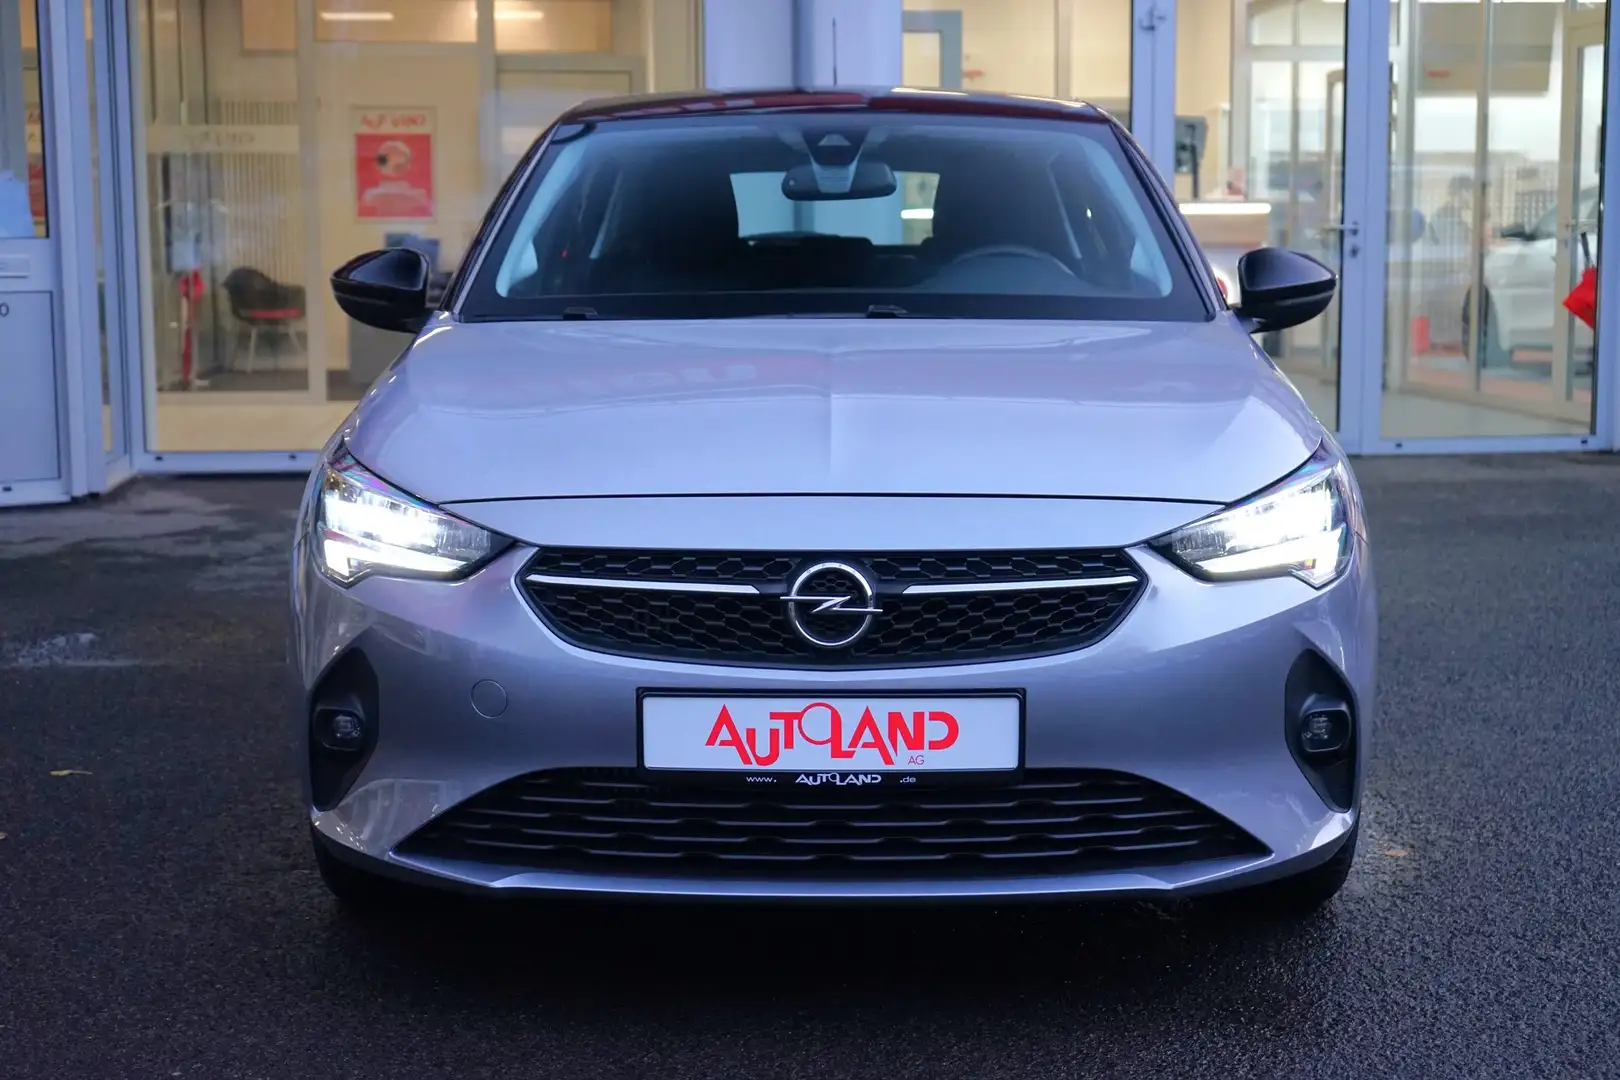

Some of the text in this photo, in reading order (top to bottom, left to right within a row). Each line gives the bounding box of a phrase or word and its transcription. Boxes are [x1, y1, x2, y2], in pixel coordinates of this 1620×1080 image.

[705, 702, 959, 766] AUTOLAND
[908, 754, 925, 765] AG
[795, 772, 882, 786] AUTOLAND
